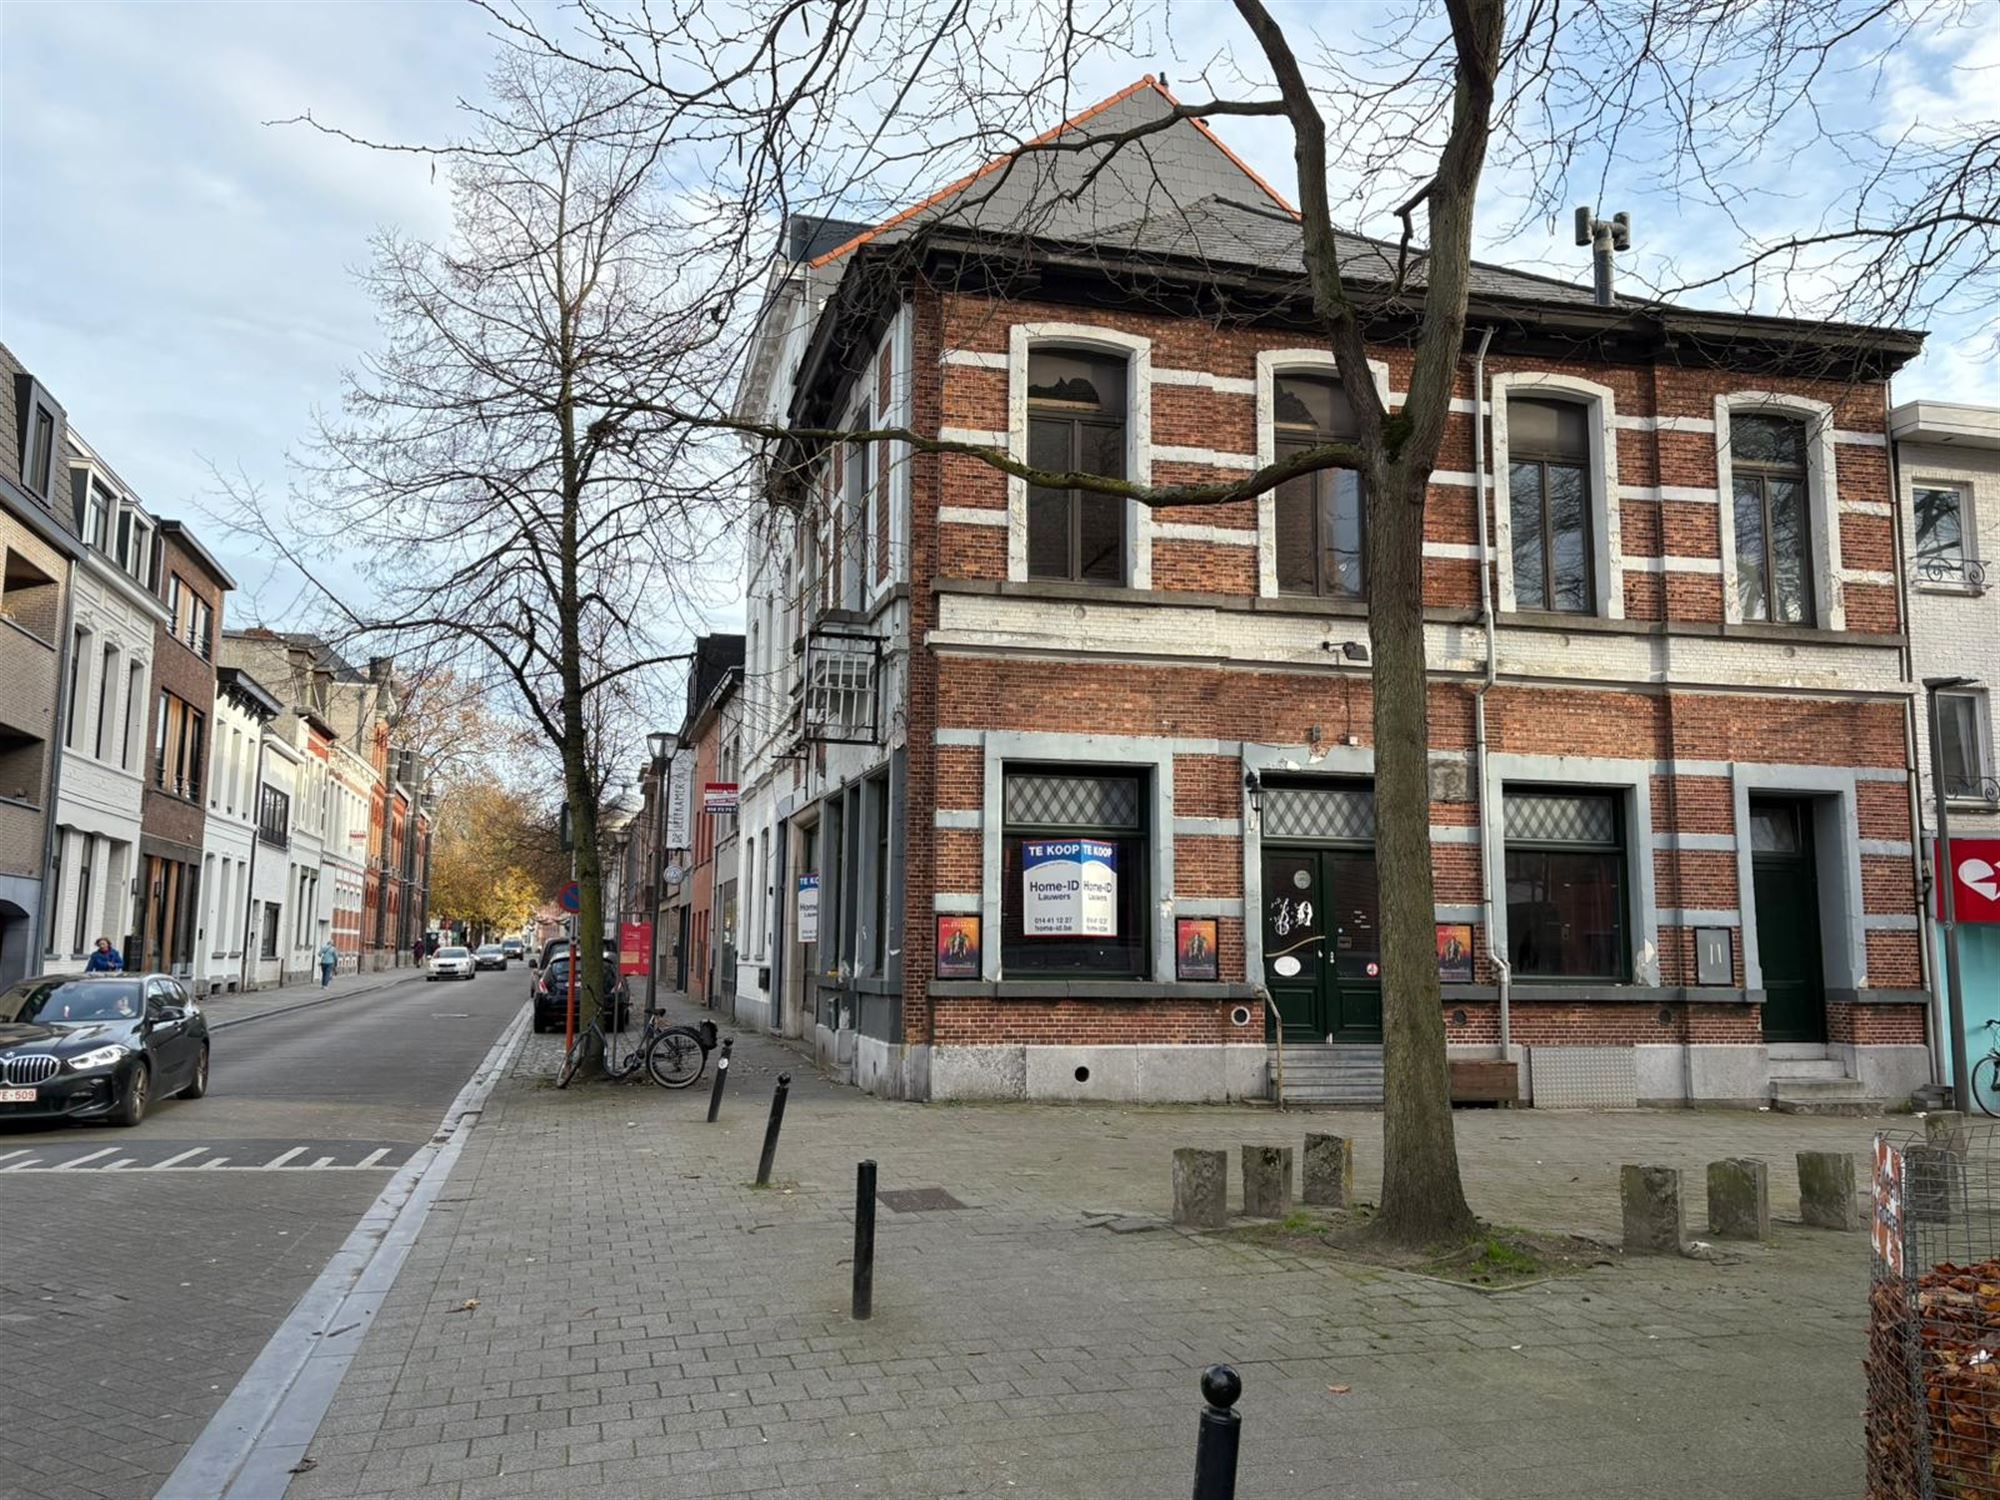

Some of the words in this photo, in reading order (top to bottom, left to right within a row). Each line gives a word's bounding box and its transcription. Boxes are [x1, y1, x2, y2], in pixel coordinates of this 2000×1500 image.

[1028, 845, 1043, 856] TE
[1046, 844, 1080, 856] KOOP
[1083, 844, 1092, 855] TE
[1093, 846, 1113, 858] KOOP
[799, 877, 808, 886] TE
[1029, 880, 1080, 892] Home-ID
[1038, 893, 1071, 901] Lauwers
